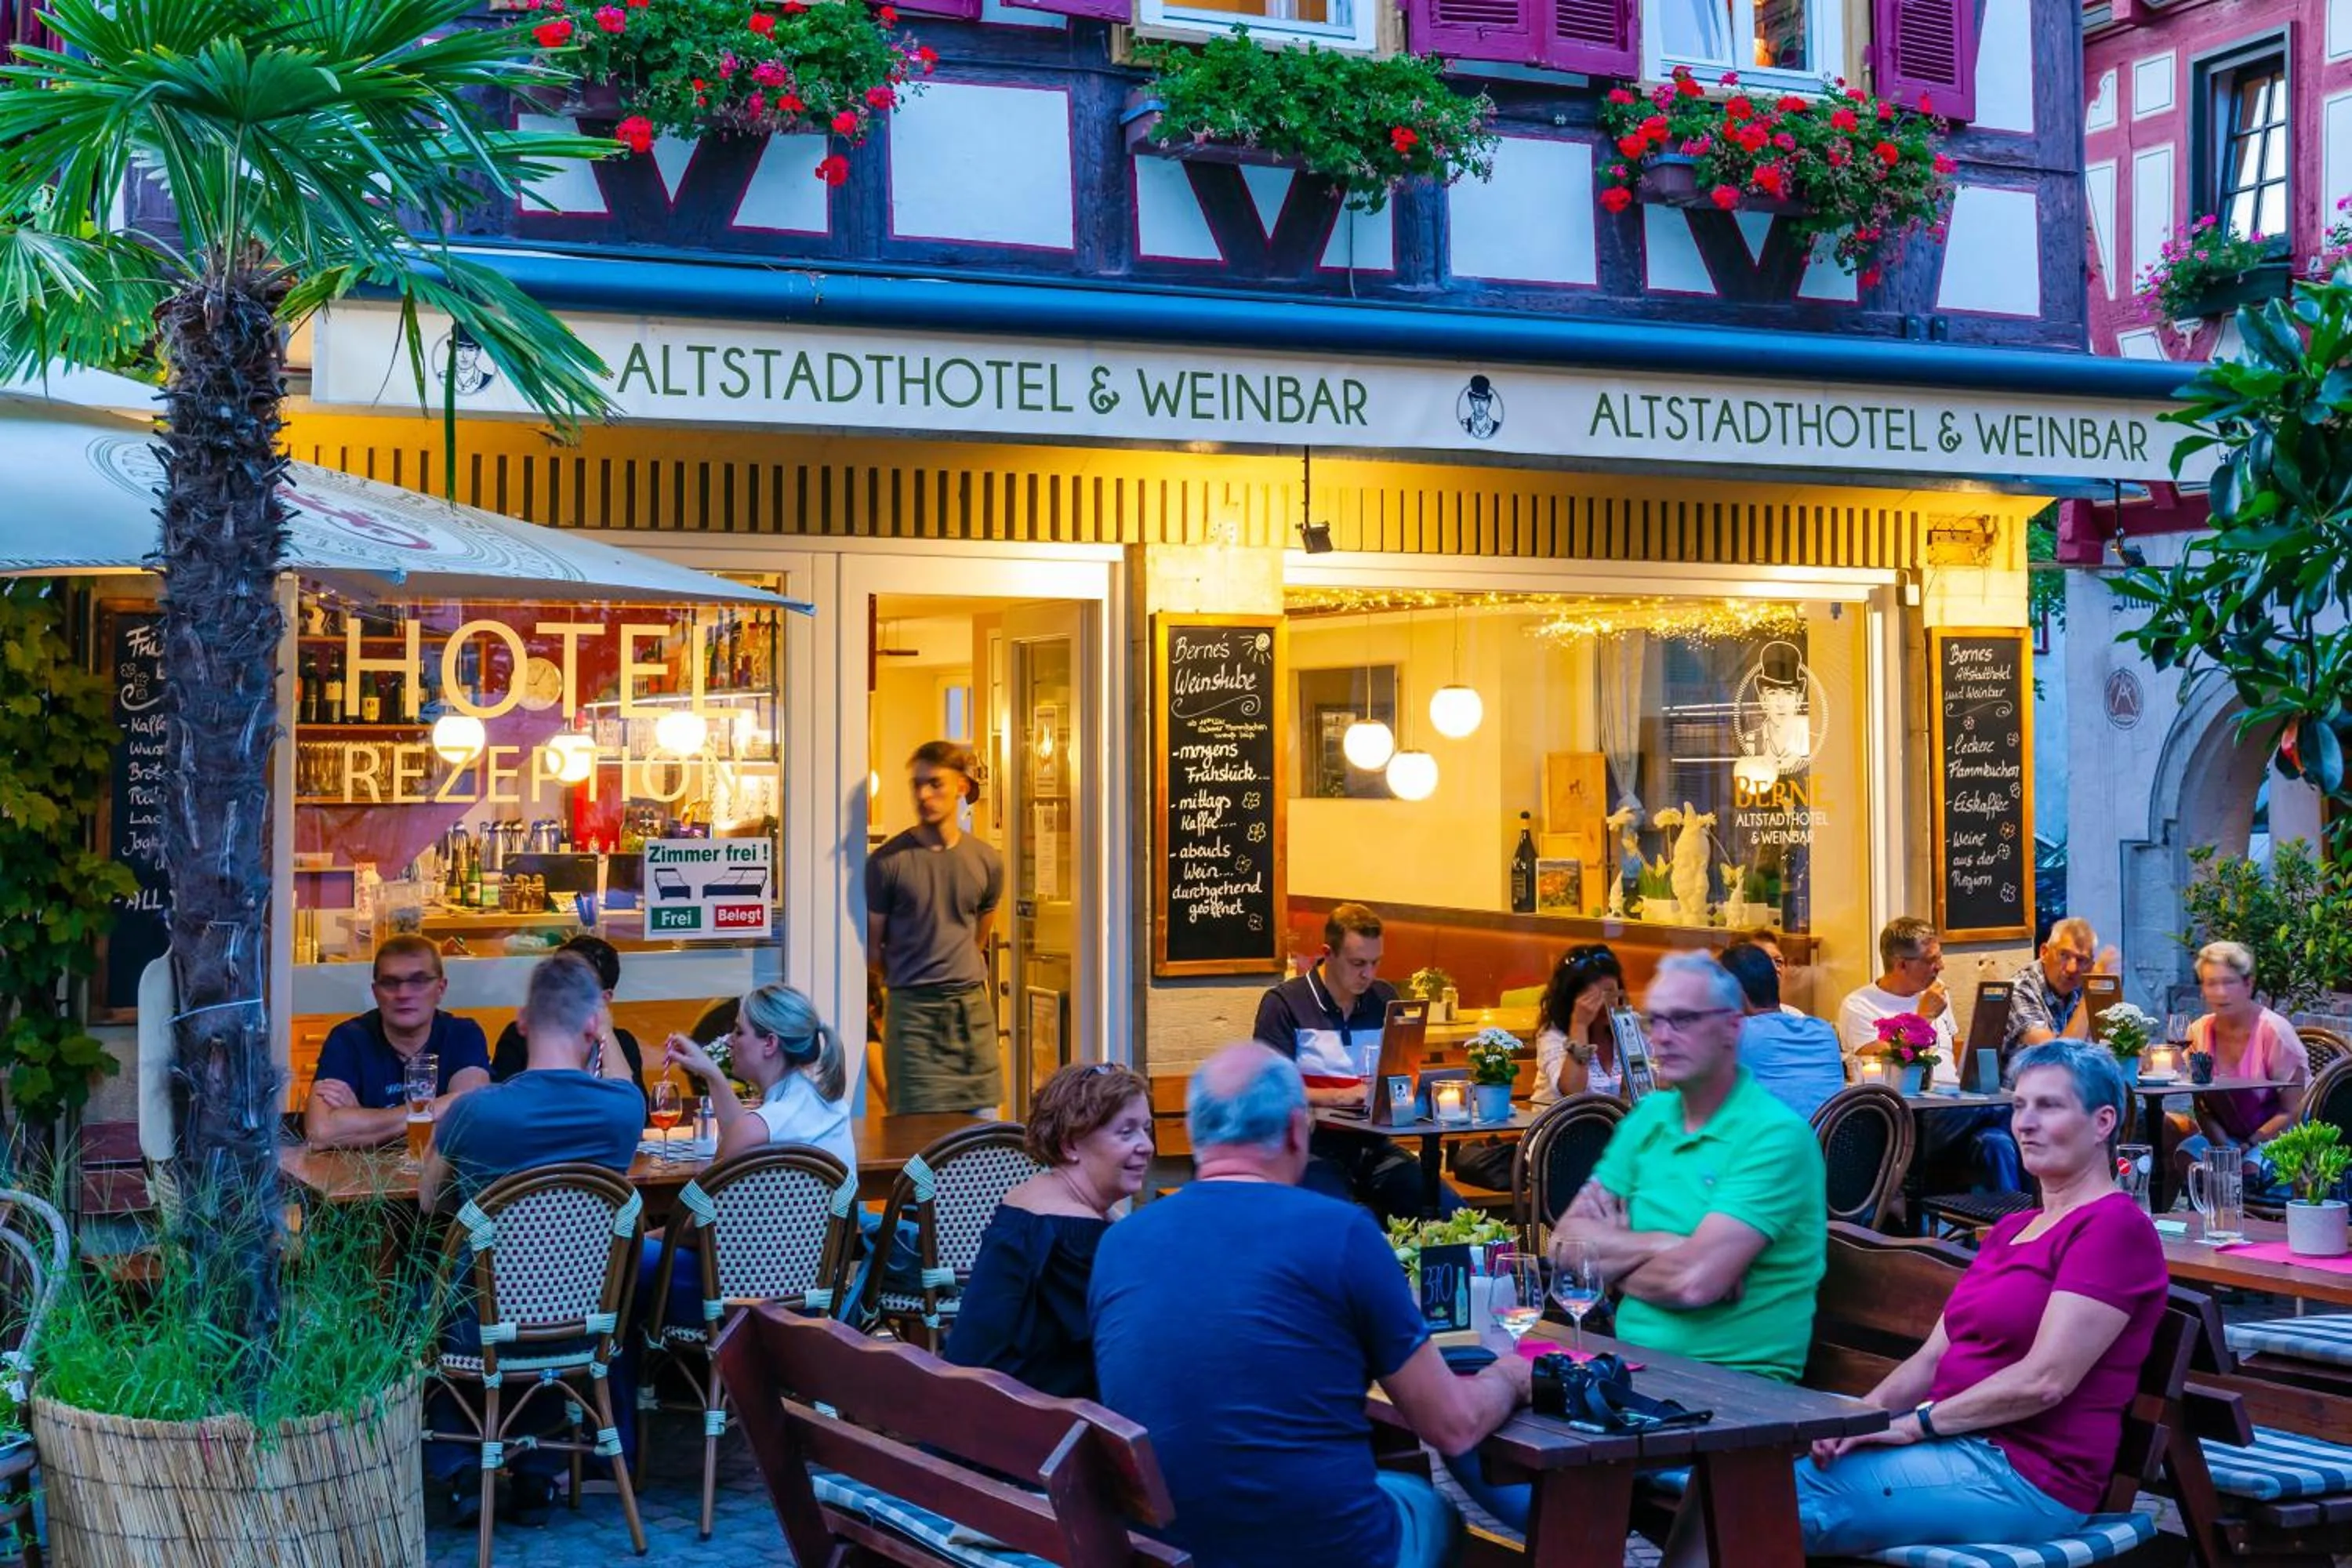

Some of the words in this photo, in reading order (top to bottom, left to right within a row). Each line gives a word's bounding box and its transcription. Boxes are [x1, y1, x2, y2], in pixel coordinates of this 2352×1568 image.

[617, 341, 1073, 413] ALTSTADTHOTEL
[1089, 365, 1120, 414] &
[1136, 368, 1368, 426] WEINBAR
[1588, 392, 1928, 452] ALTSTADTHOTEL
[1937, 411, 1962, 452] &
[1974, 412, 2149, 463] WEINBAR
[345, 618, 742, 720] HOTEL
[1175, 662, 1258, 696] Weinstube
[343, 745, 743, 804] REZEPTION
[1179, 789, 1231, 818] mittags
[1735, 811, 1830, 827] ALTSTADTHOTEL
[1179, 836, 1231, 858] abends
[1760, 830, 1815, 844] WEINBAR
[1953, 830, 1987, 848] Weine
[648, 845, 720, 863] Zimmer
[726, 844, 757, 862] frei
[1953, 855, 1973, 866] aus
[1976, 850, 1997, 866] der
[1172, 872, 1263, 902] durchgehend
[1951, 869, 1992, 895] Region
[661, 910, 691, 927] Frei
[717, 908, 762, 924] Belegt
[1189, 899, 1245, 924] geöffnet
